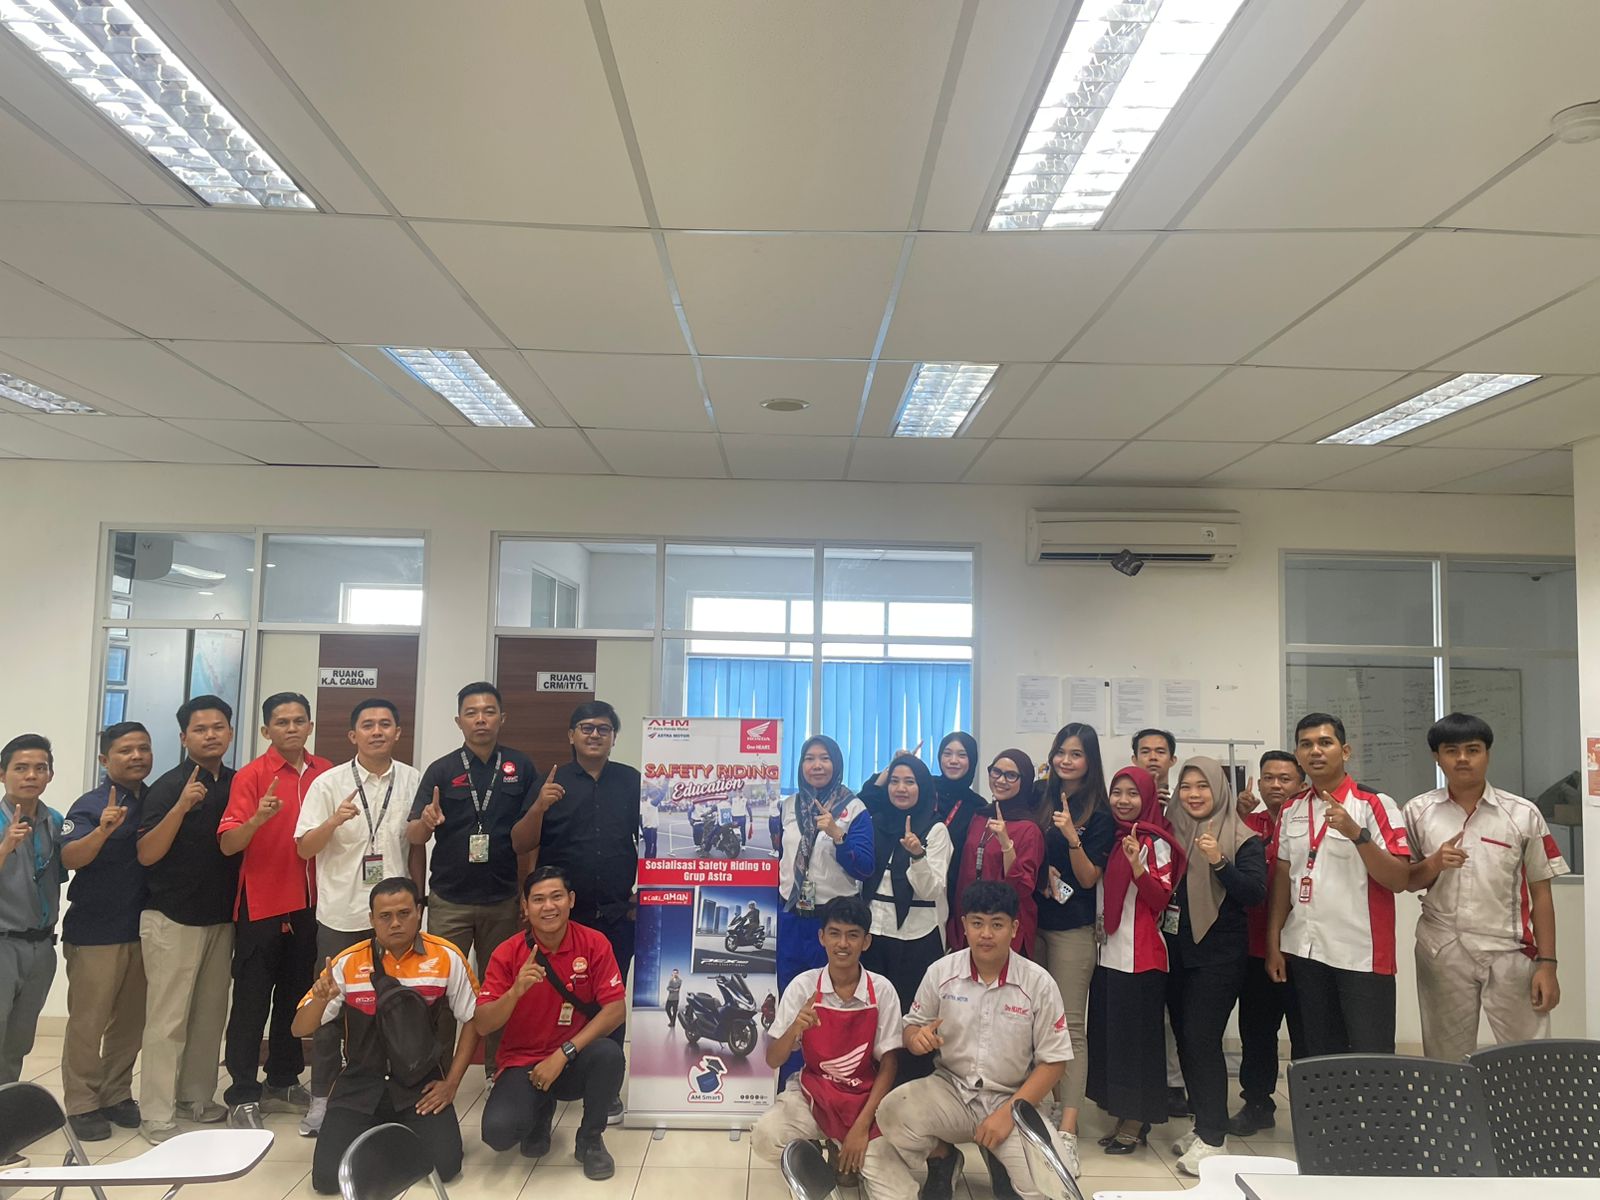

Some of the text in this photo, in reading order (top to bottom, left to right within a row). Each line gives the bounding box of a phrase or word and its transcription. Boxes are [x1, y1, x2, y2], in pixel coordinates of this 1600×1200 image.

[332, 670, 364, 678] RUANG
[550, 674, 582, 682] RUANG
[321, 678, 375, 686] K.A. CABANG
[543, 682, 589, 690] CRM/IT/TL
[644, 763, 779, 780] SAFETY RIDING
[672, 776, 746, 801] Education
[645, 860, 771, 872] Sosialisasi Safety Riding to
[683, 872, 733, 882] Grup Astra
